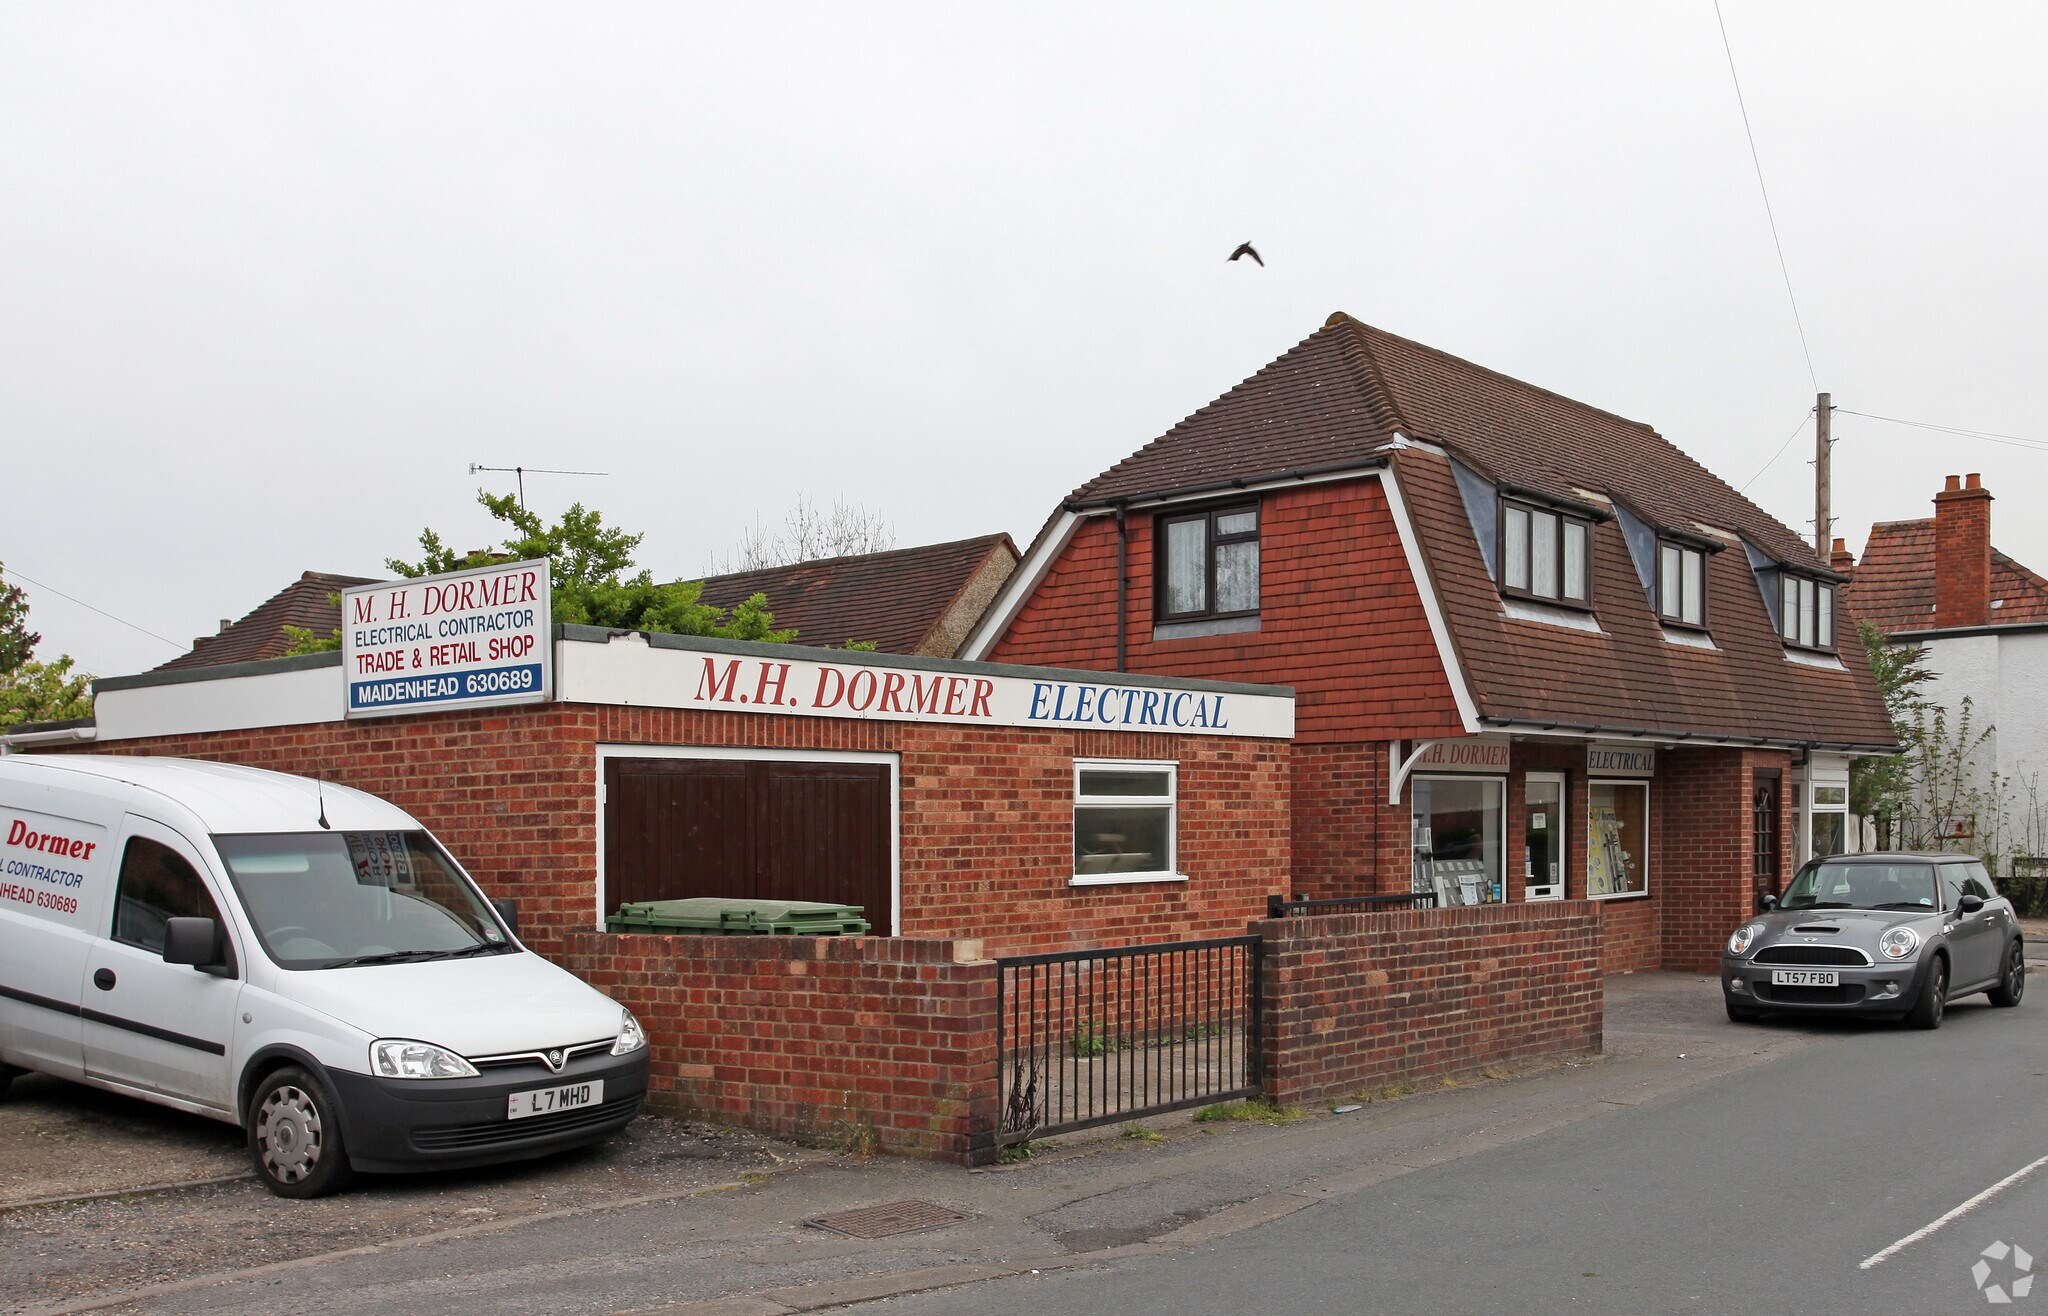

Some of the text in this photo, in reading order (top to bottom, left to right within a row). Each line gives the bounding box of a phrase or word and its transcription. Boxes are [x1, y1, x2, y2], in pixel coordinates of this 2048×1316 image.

[353, 571, 538, 625] M. H. DORMER
[355, 609, 534, 648] ELECTRICAL CONTRACTOR
[356, 634, 535, 675] TRADE & RETAIL SHOP
[358, 669, 533, 704] MAIDENHEAD 630689
[693, 656, 1229, 729] M.H. DORMER ELECTRICAL
[1449, 744, 1509, 765] DORMER
[1588, 750, 1654, 771] ELECTRICAL
[6, 819, 96, 861] Dormer
[7, 860, 84, 888] CONTRACTOR
[37, 891, 78, 914] 630689
[1775, 971, 1834, 985] LT57 FBO
[559, 1084, 590, 1108] MHD
